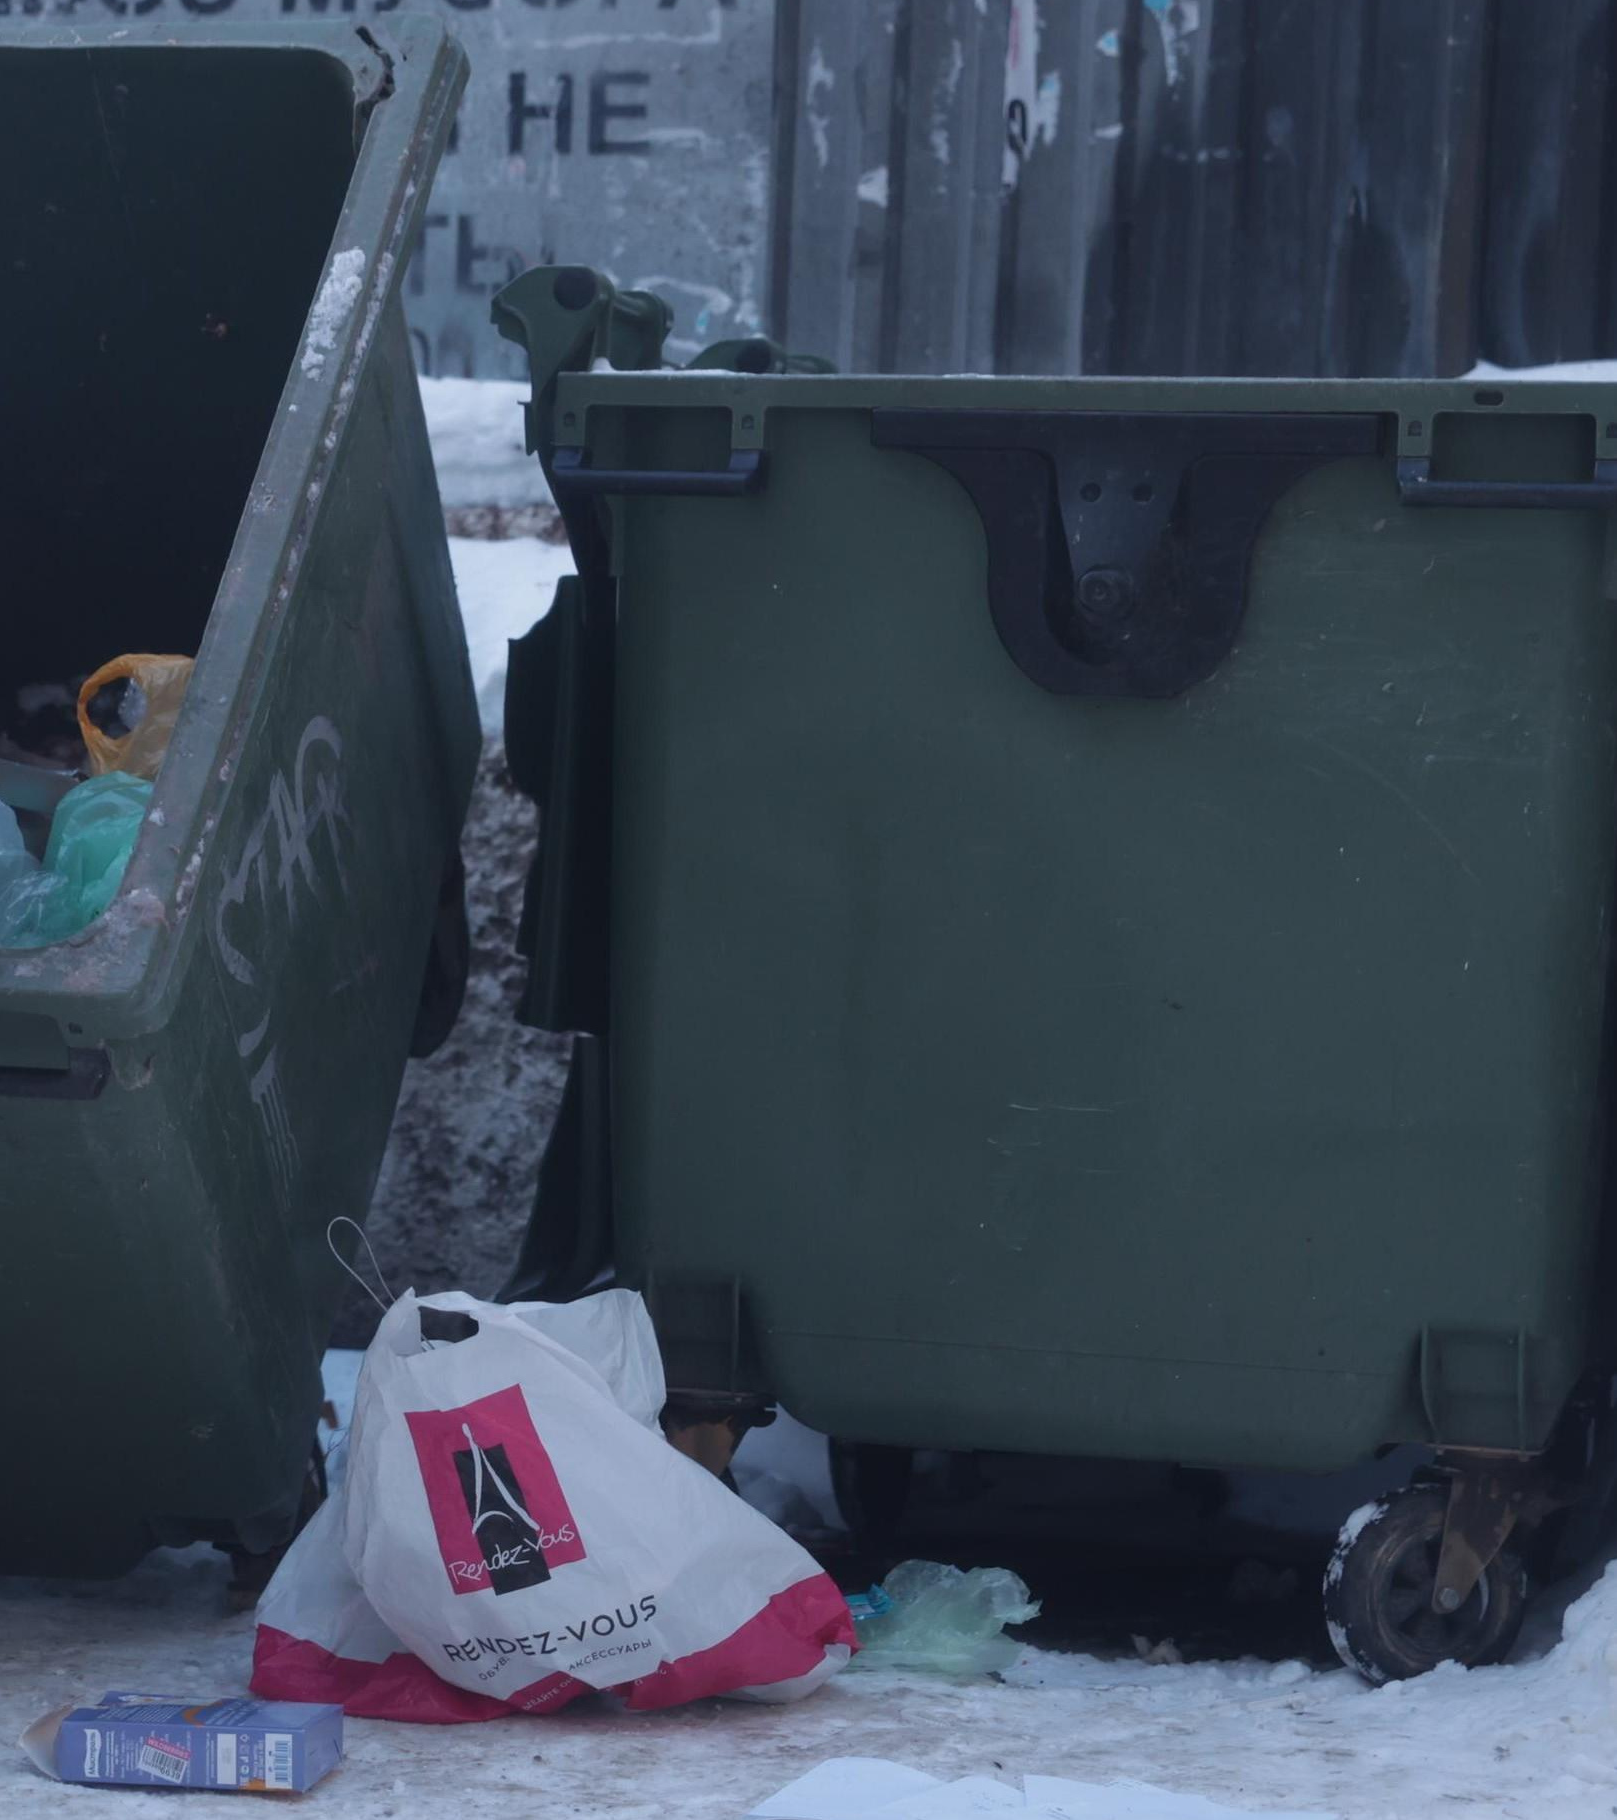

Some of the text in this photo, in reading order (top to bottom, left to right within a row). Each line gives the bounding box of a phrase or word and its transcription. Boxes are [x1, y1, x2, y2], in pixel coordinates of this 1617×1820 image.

[508, 71, 651, 156] НЕ
[448, 1523, 575, 1584] Rendez-Vous
[442, 1595, 657, 1662] RENDEZ-VOUS
[568, 1640, 652, 1671] АКСЕССУАРЫ
